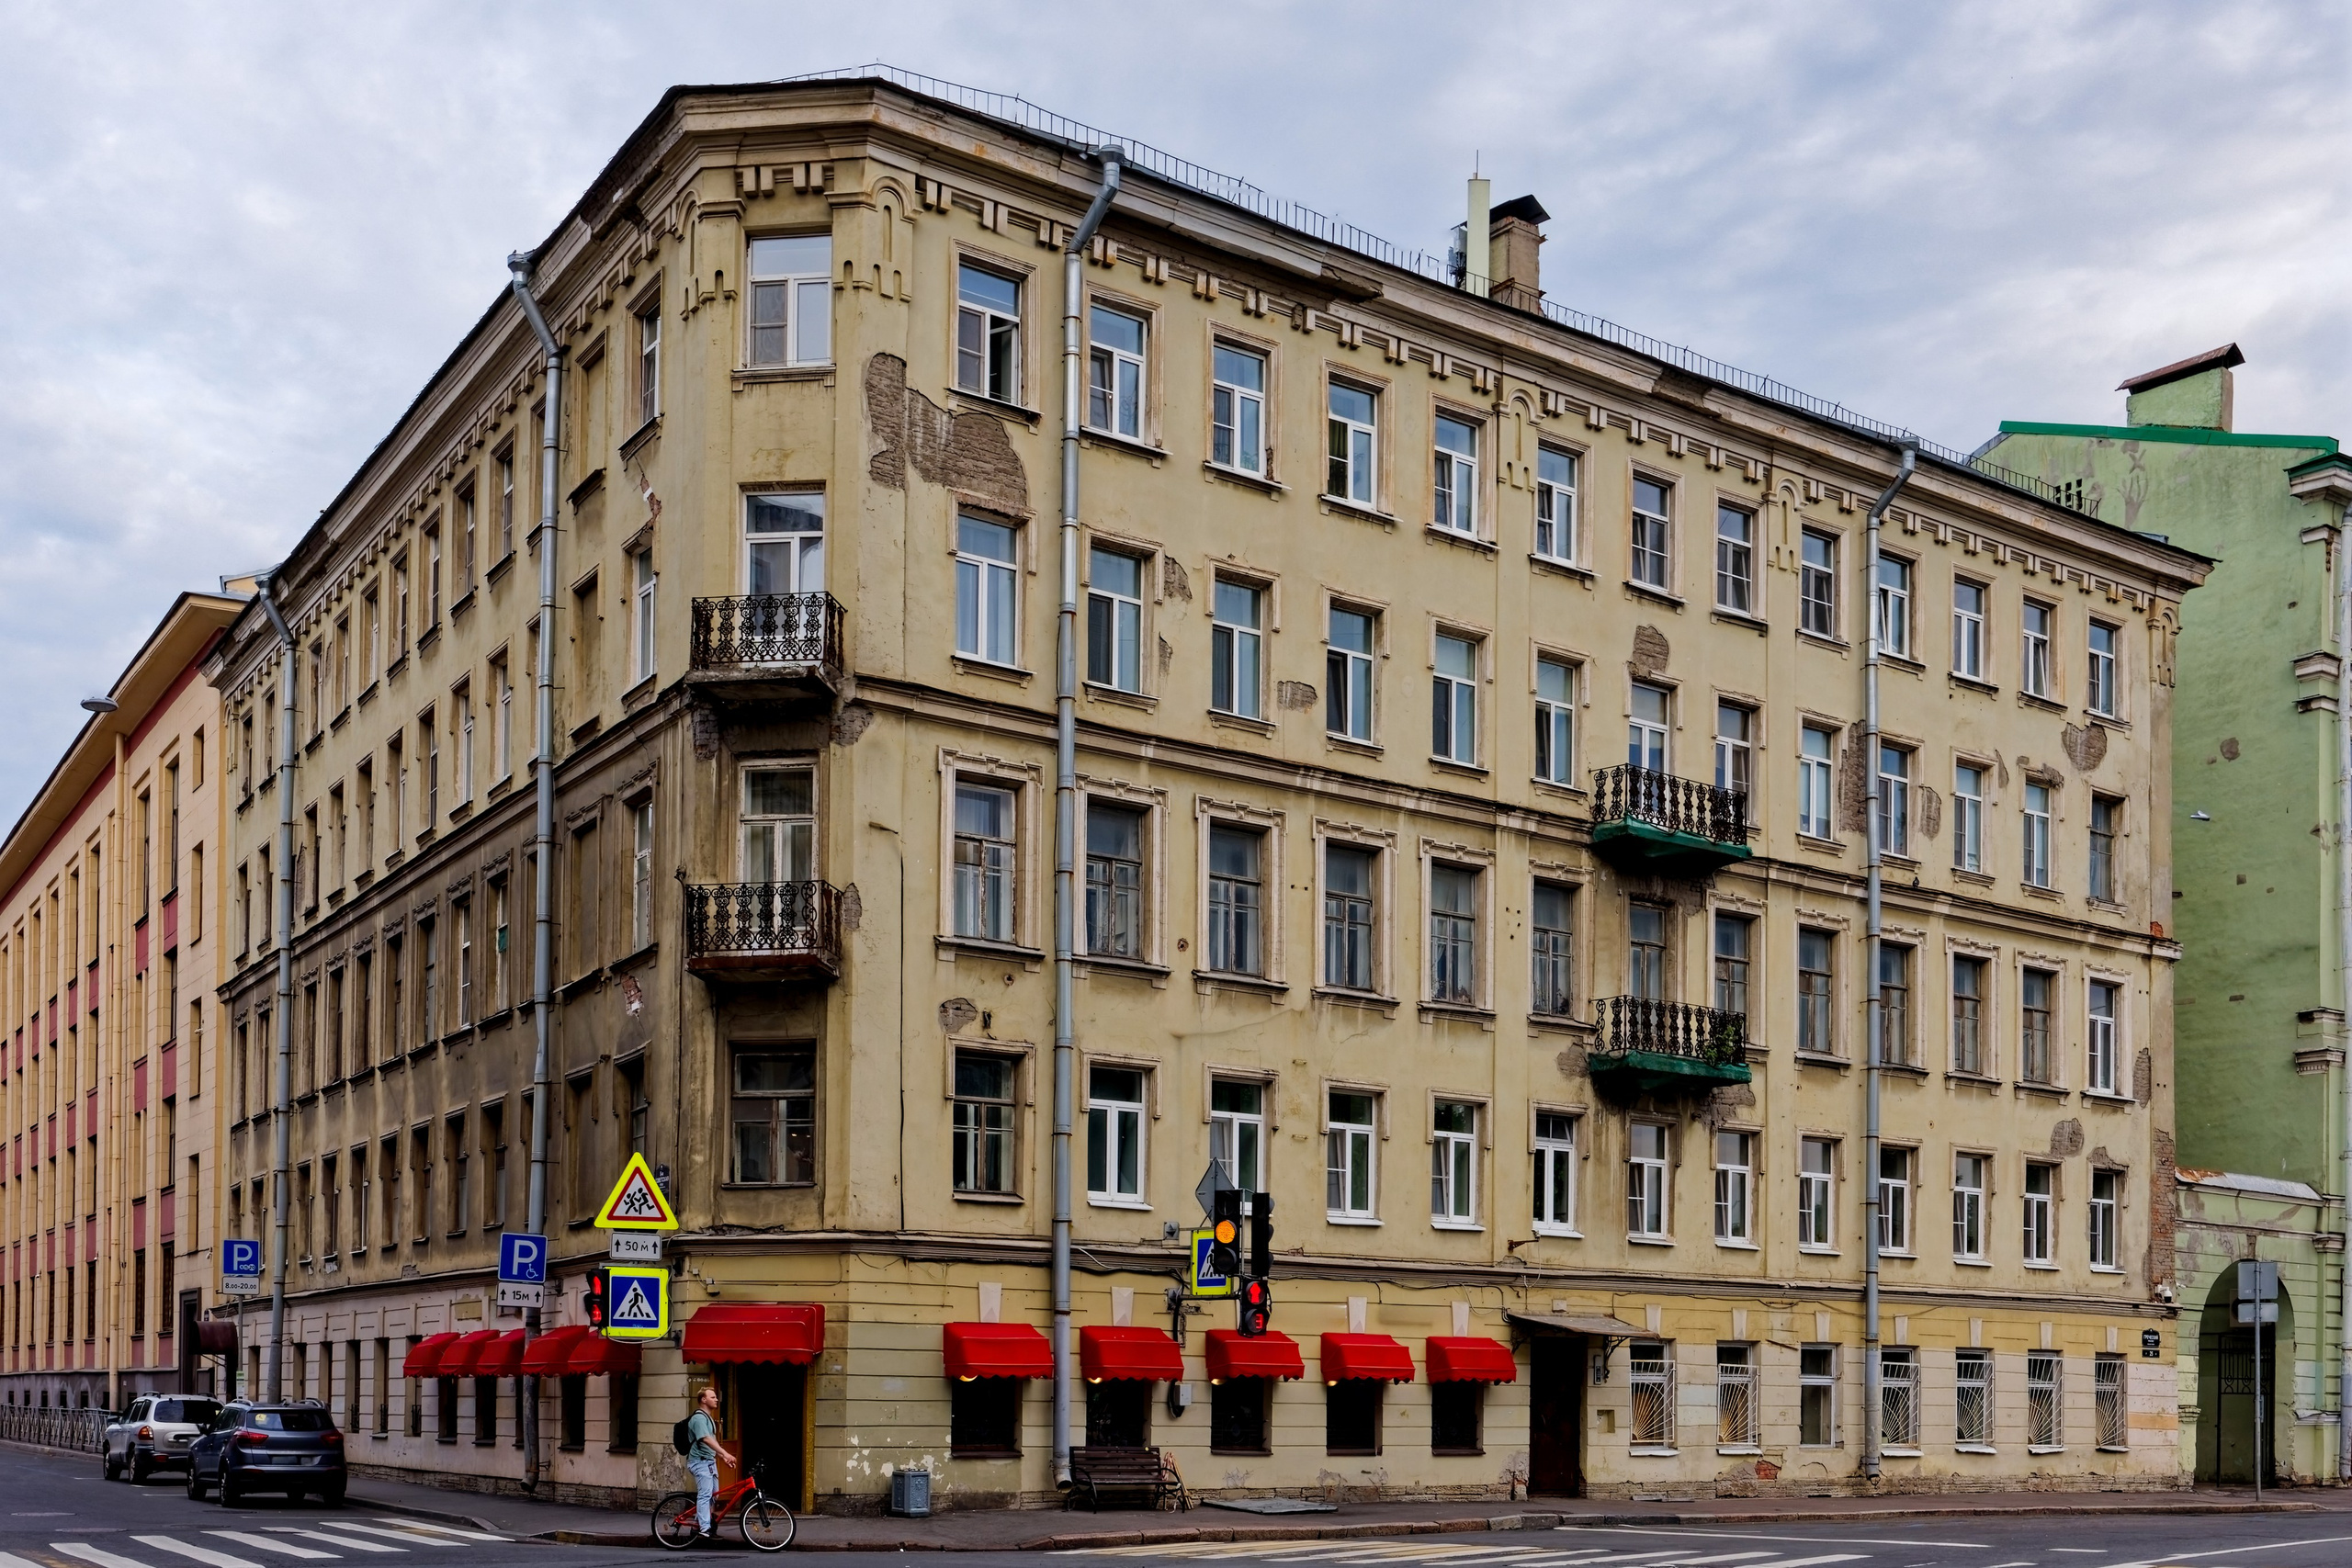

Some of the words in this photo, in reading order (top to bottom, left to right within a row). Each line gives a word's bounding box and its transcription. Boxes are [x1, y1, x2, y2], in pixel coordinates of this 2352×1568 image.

[233, 1244, 253, 1270] P
[512, 1239, 537, 1275] P
[625, 1241, 638, 1251] 50
